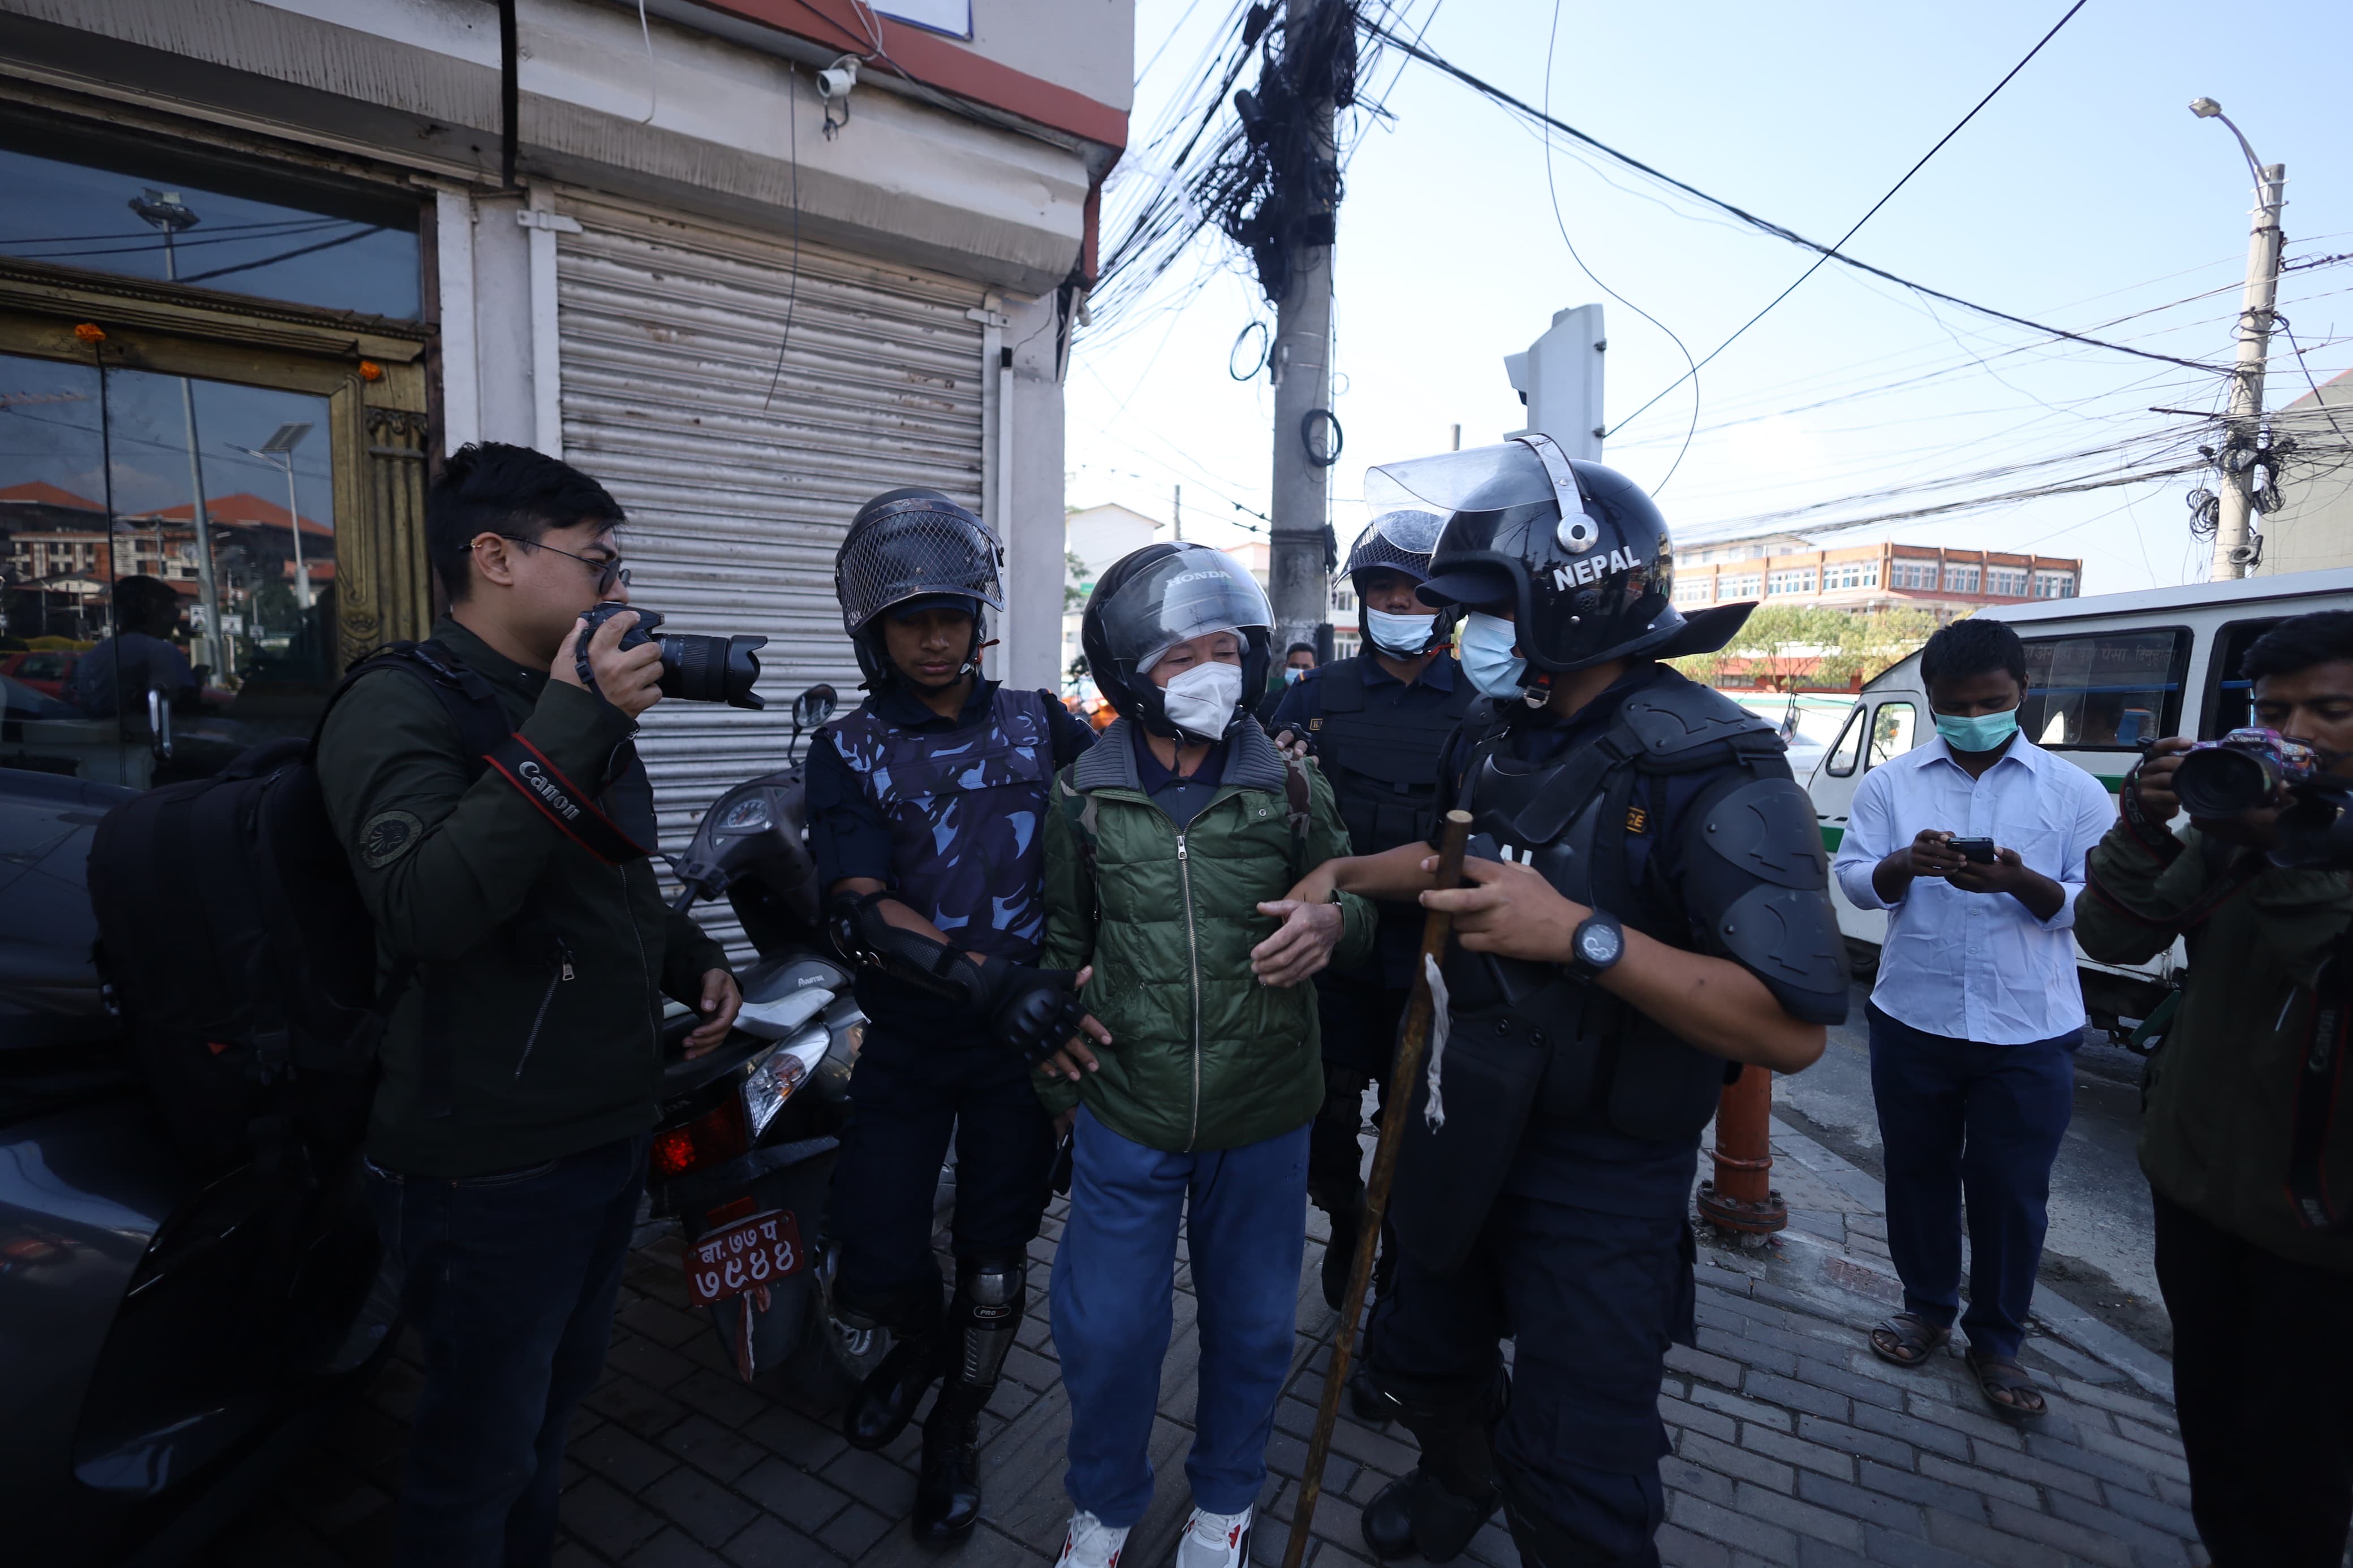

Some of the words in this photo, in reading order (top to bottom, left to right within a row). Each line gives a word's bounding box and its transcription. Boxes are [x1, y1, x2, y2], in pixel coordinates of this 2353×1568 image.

[1165, 571, 1232, 588] HONDA
[1553, 546, 1641, 591] NEPAL
[519, 761, 580, 820] Canon
